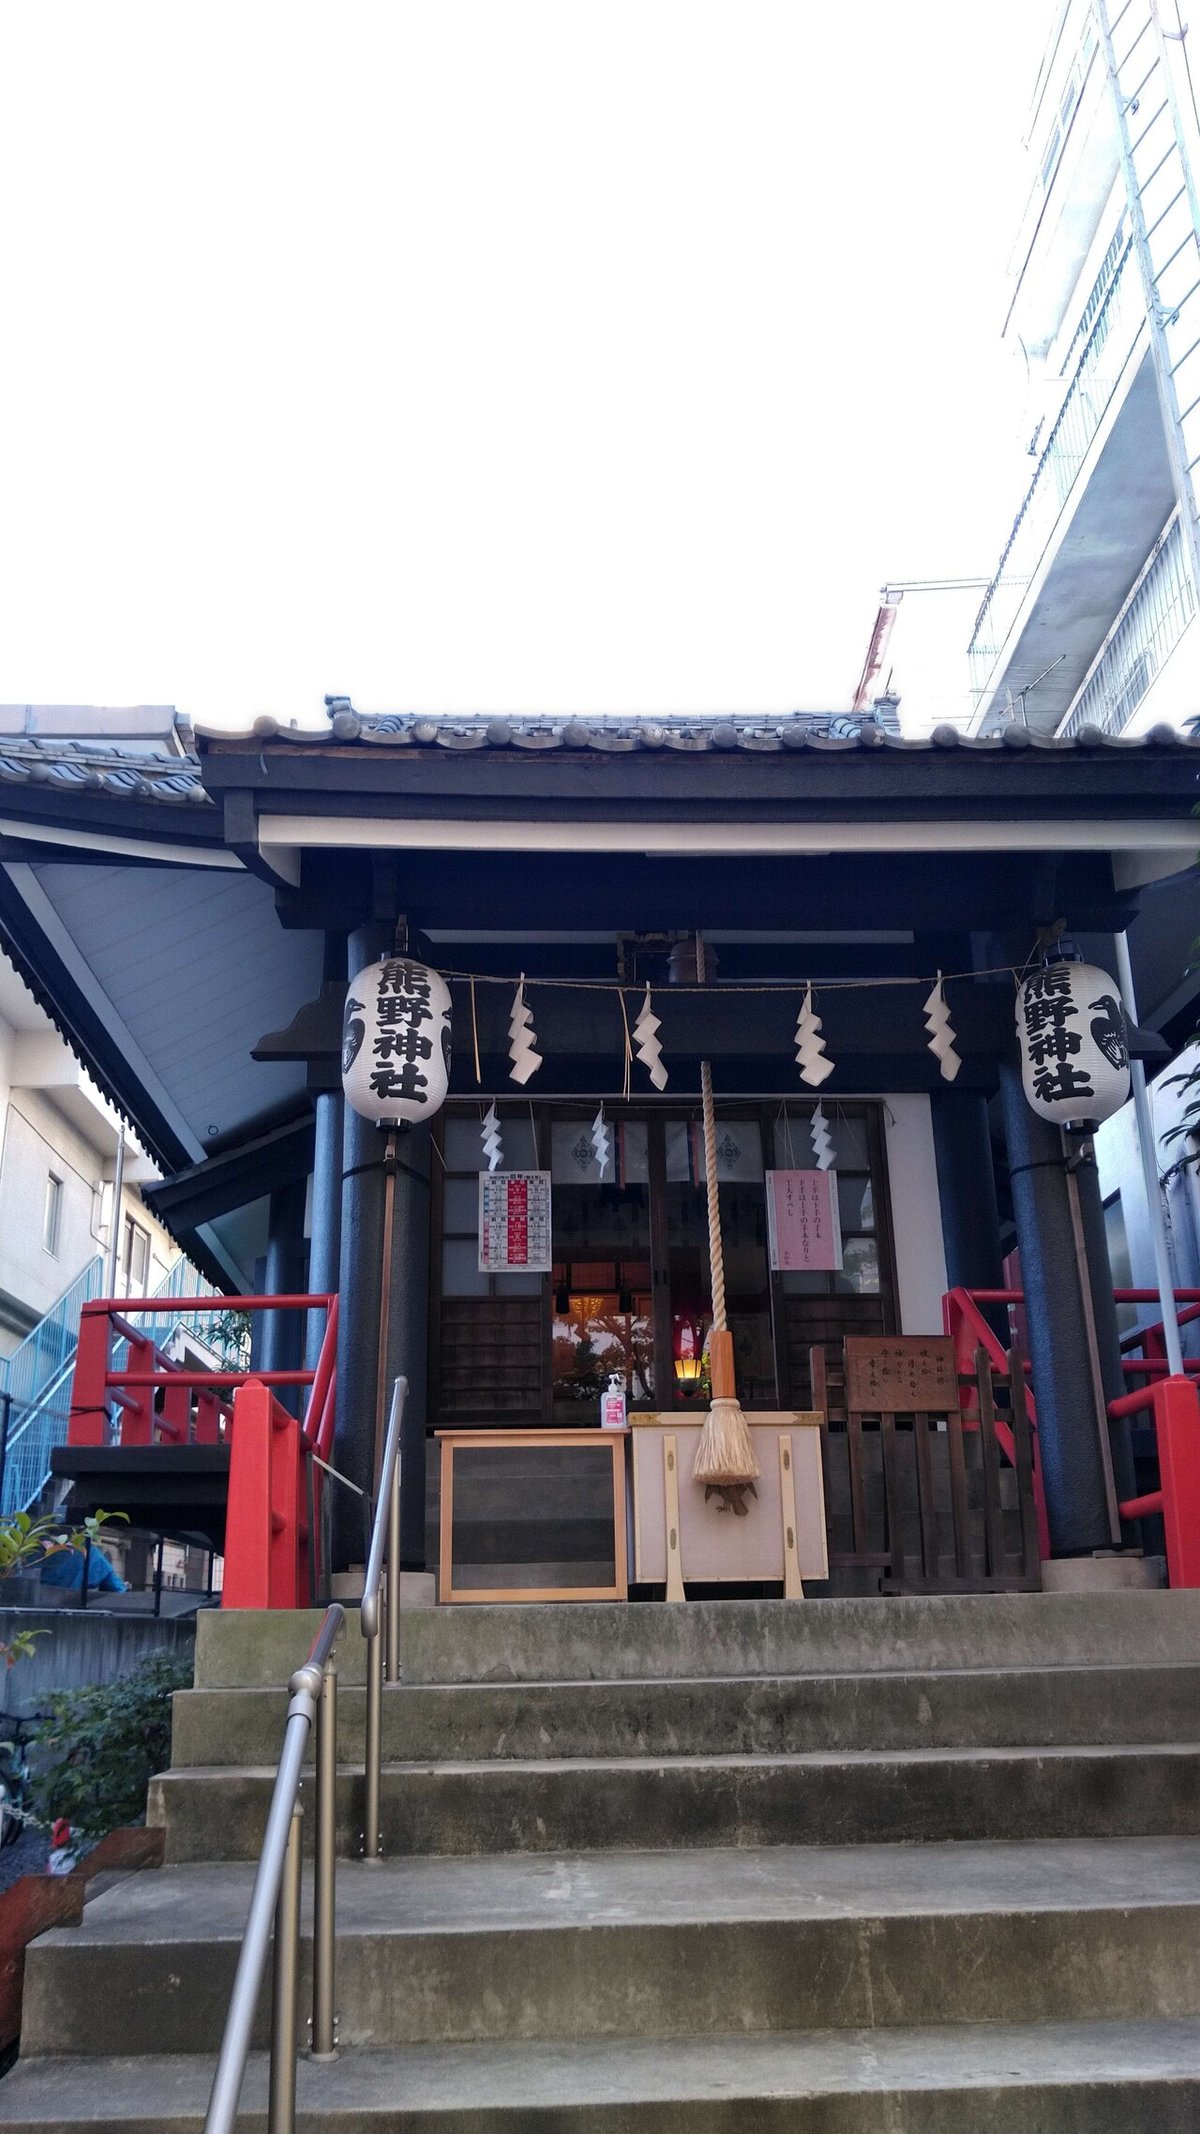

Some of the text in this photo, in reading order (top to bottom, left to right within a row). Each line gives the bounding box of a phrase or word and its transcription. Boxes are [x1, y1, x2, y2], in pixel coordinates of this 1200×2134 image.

[369, 961, 433, 1103] 熊野神社
[1024, 967, 1095, 1102] 熊野神社
